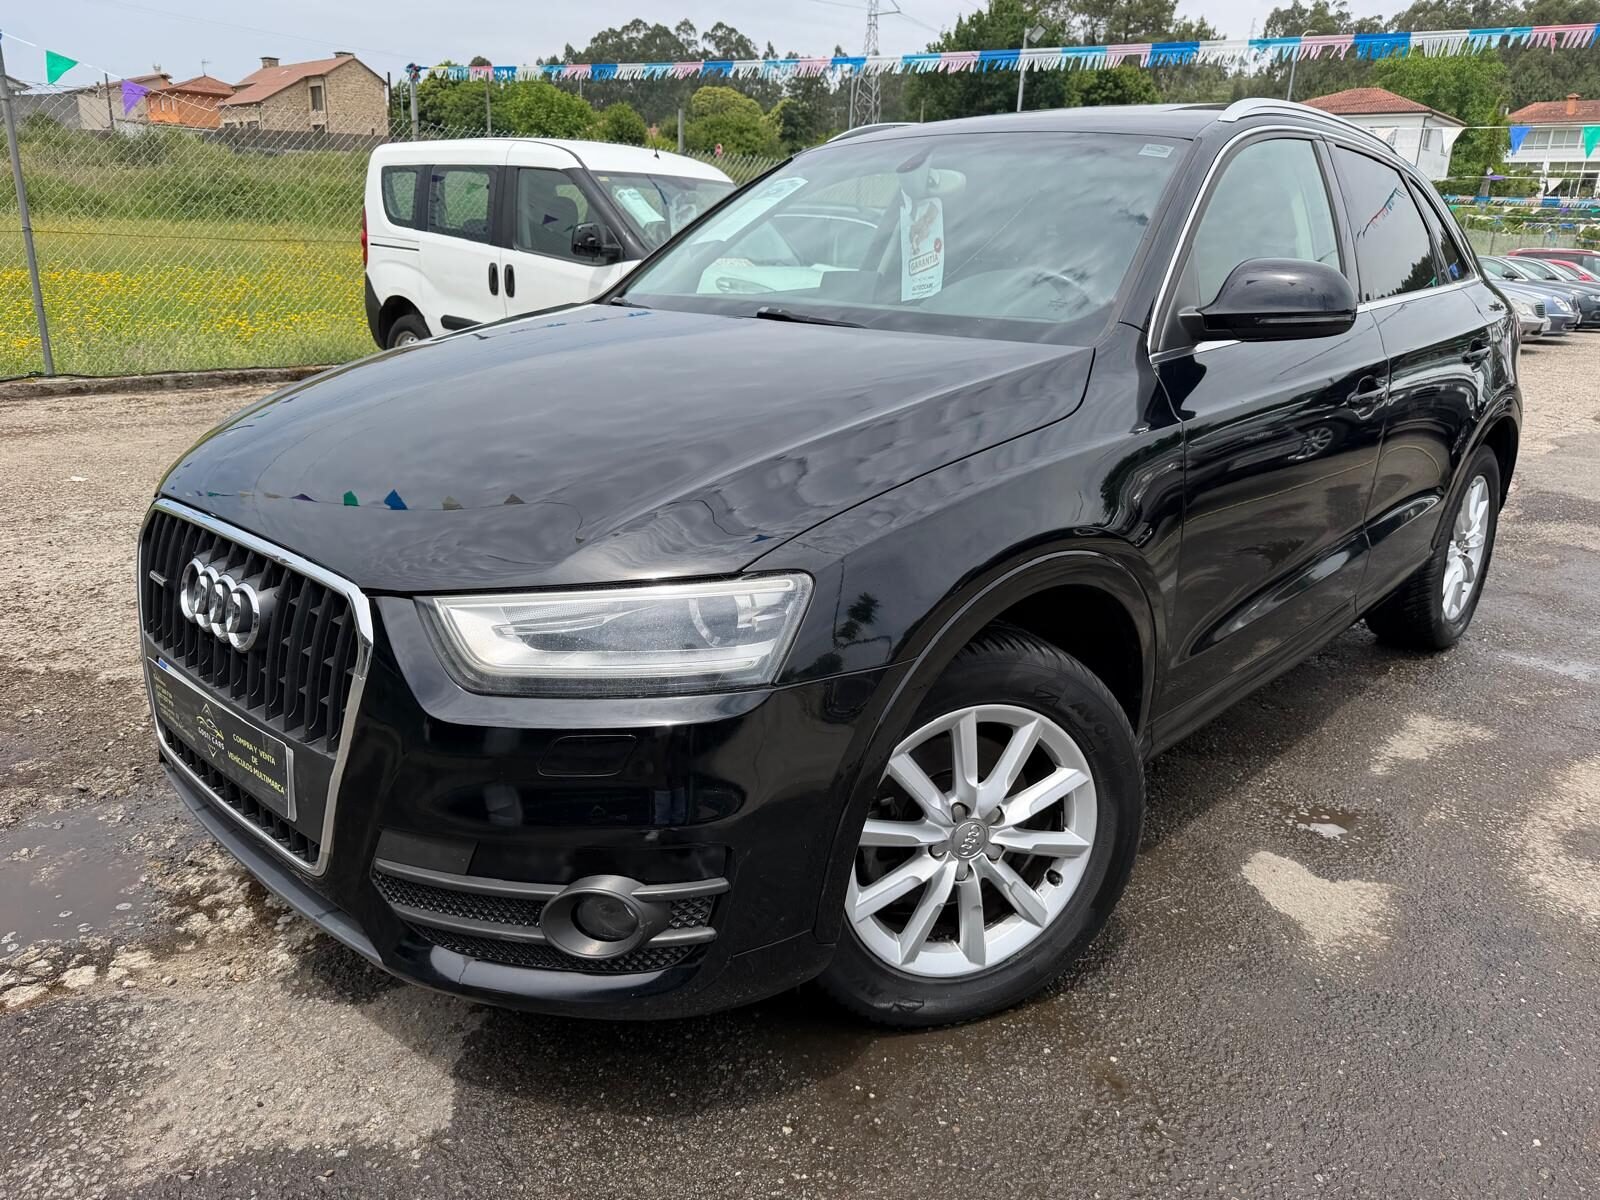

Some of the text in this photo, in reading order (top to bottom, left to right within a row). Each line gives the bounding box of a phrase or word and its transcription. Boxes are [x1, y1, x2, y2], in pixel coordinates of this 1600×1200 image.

[211, 736, 225, 750] CARS
[232, 733, 254, 754] COMPRA
[258, 749, 276, 766] VENTA
[251, 755, 258, 766] DE
[253, 767, 285, 795] MULTIMARCA
